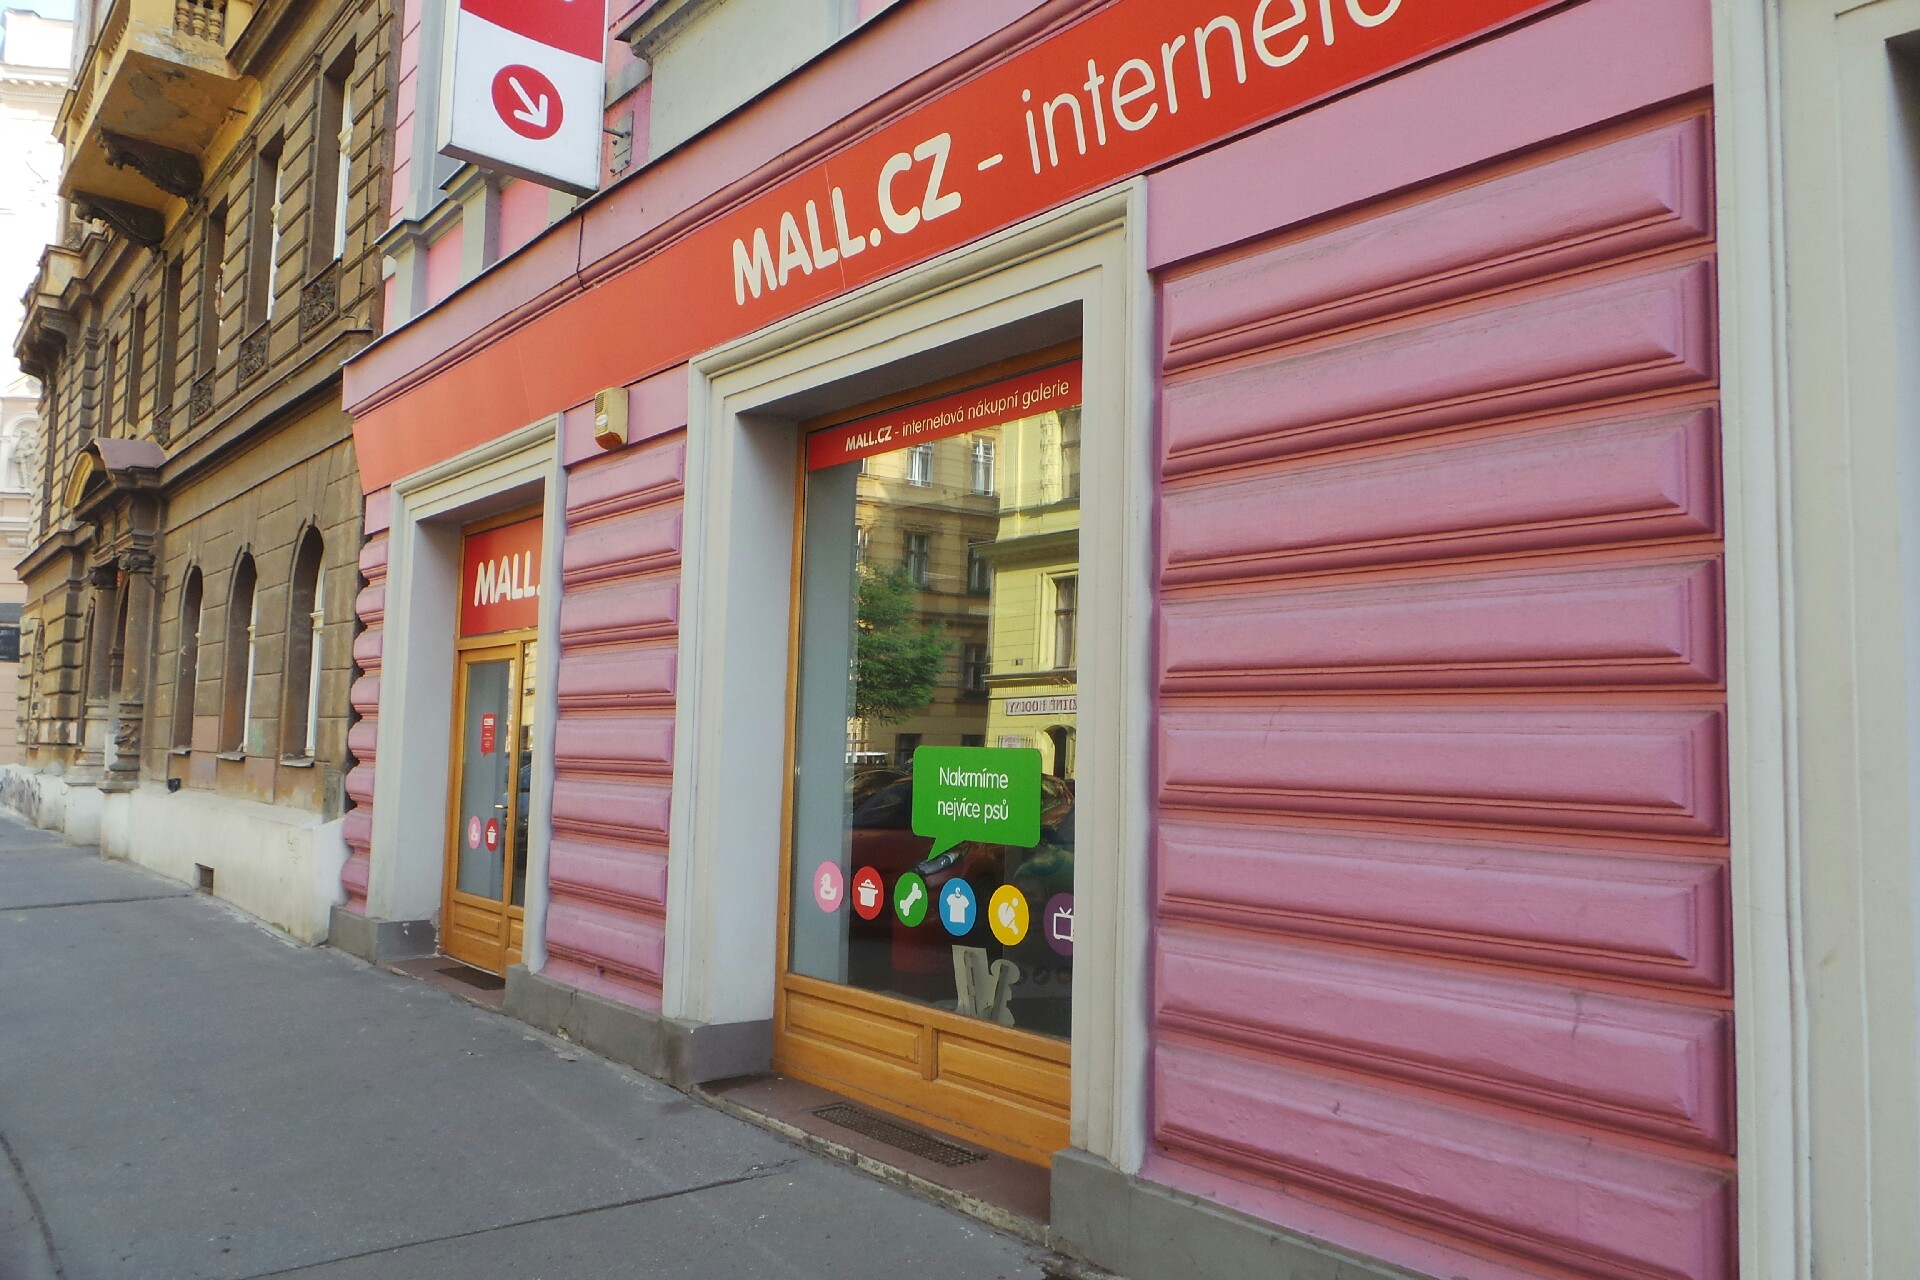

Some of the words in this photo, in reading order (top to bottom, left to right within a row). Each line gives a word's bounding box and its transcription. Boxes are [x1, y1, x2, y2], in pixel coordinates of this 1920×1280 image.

[732, 132, 962, 306] MALL.CZ
[977, 153, 1003, 171] -
[846, 425, 892, 452] MALL.CZ
[902, 407, 964, 437] internetová
[968, 390, 1018, 420] nákupní
[1022, 381, 1069, 409] galerie
[939, 766, 1008, 789] Nakrmíme
[937, 797, 980, 821] nejvíce
[984, 799, 1009, 824] psů
